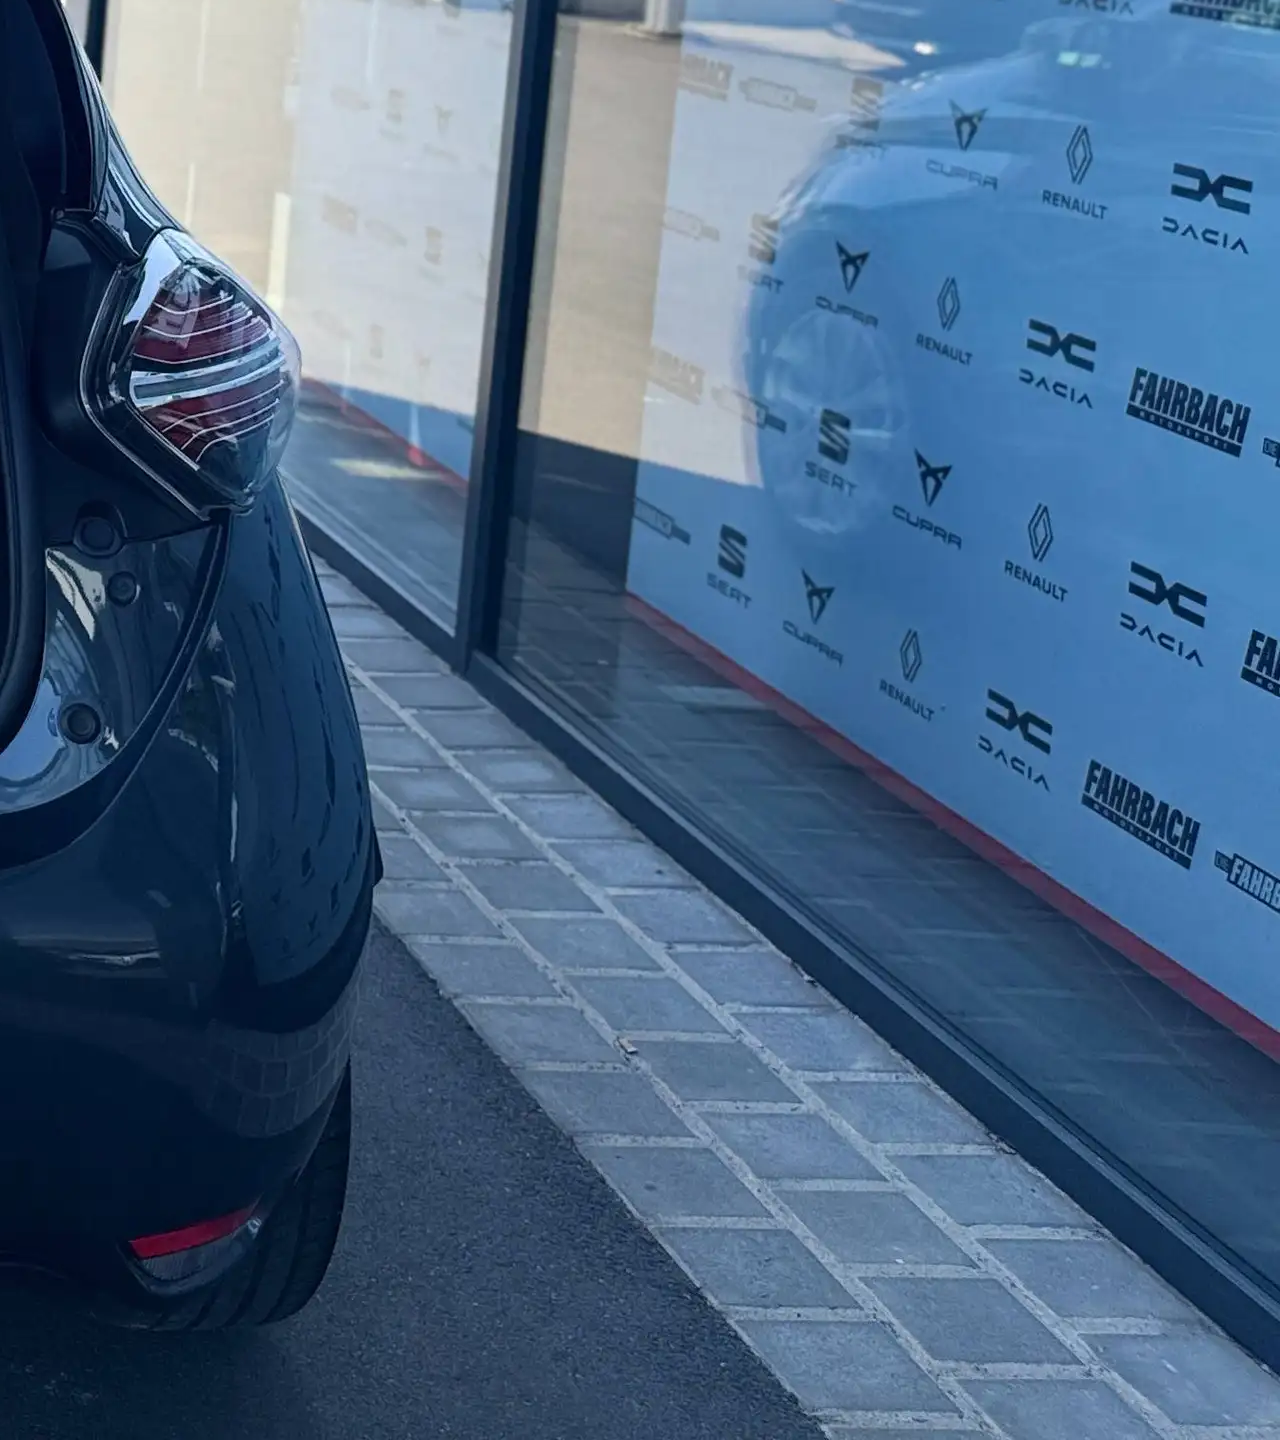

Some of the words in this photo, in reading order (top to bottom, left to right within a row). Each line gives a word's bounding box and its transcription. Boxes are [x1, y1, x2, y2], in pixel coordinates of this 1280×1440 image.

[926, 159, 998, 191] CUPRA
[1042, 189, 1108, 220] RENAULT
[1161, 216, 1249, 254] DACIA
[815, 295, 879, 329] CUPRA
[916, 333, 973, 365] RENAULT
[1019, 368, 1093, 410] DACIA
[1129, 366, 1251, 443] FAHRBACH
[804, 462, 858, 497] SEAT
[892, 505, 963, 550] CUPRA
[706, 572, 752, 609] SEAT
[1004, 560, 1068, 602] RENAULT
[782, 620, 844, 666] CUPRA
[1119, 612, 1204, 667] DACIA
[1244, 629, 1280, 681] FA
[879, 679, 935, 722] RENAULT
[977, 734, 1051, 793] DACIA
[1084, 759, 1201, 857] FAHRBACH
